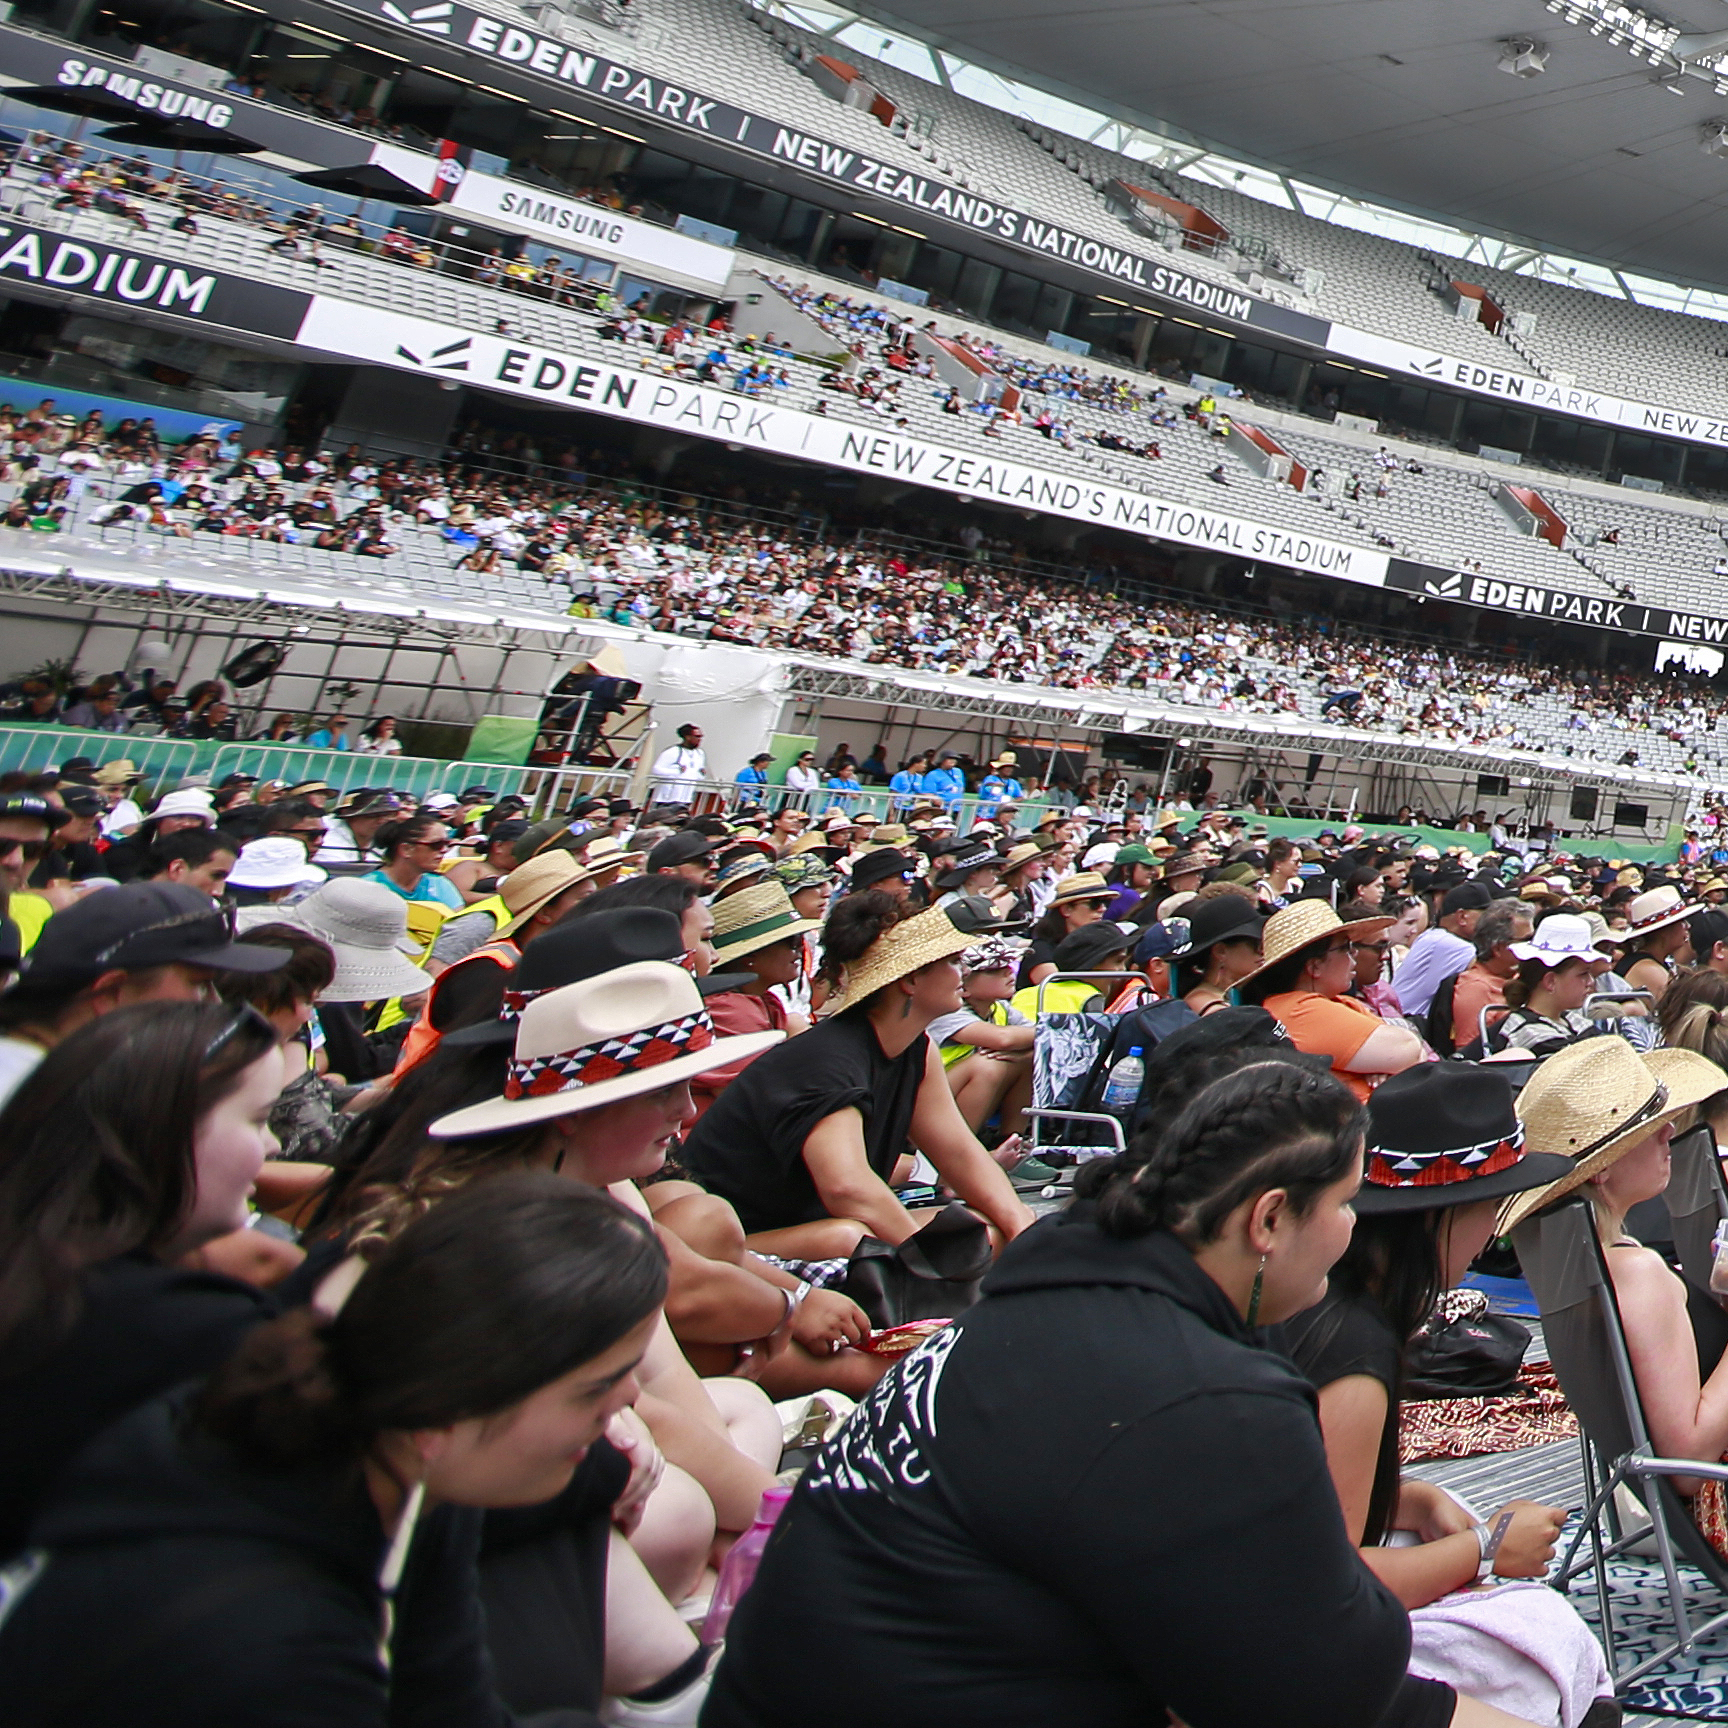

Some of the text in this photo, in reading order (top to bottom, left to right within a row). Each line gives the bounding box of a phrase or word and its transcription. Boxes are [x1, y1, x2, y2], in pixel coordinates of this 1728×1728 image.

[56, 57, 235, 129] SAMSUNG
[466, 15, 1253, 322] EDEN PARK NEW ZEALAND'S NATIONAL STADIUM
[499, 191, 627, 244] SAMSUNG
[1454, 363, 1525, 398] EDEN
[1530, 383, 1601, 416] PARK
[1642, 408, 1701, 436] NEW
[495, 348, 1354, 573] EDEN PARK NEW ZEALAND'S NATIONAL STADIUM
[1470, 577, 1546, 613] EDEN
[1550, 593, 1626, 628] PARK
